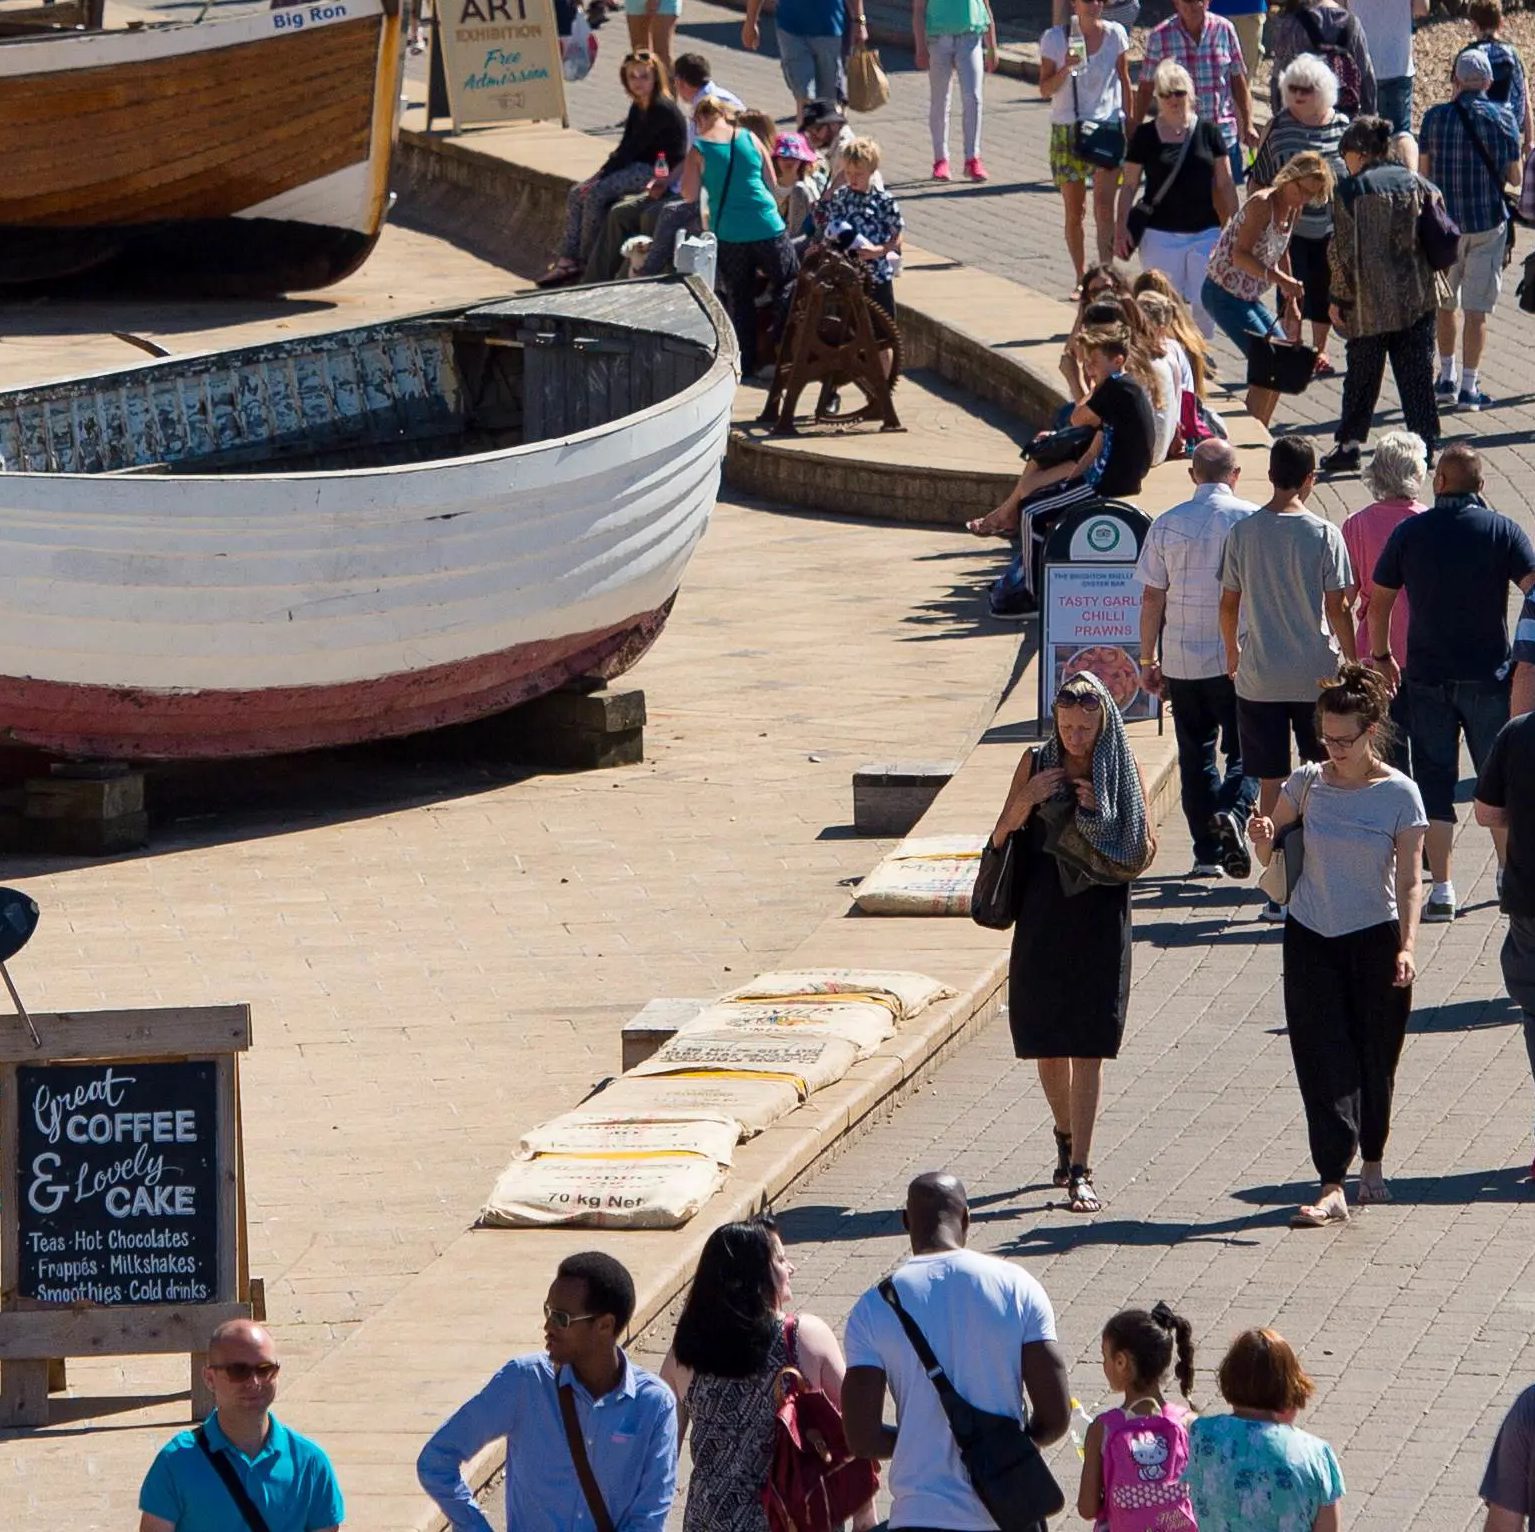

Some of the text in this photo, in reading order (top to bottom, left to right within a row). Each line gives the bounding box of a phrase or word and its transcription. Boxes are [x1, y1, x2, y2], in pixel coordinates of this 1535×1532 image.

[273, 5, 347, 29] Big Ron
[456, 25, 542, 42] EXHIBITION
[484, 48, 522, 69] Free
[464, 63, 549, 90] Admission
[1058, 597, 1099, 607] TASTY
[1082, 611, 1125, 622] CHILLI
[1074, 626, 1133, 637] PRAWNS
[32, 1068, 137, 1144] Great
[66, 1110, 198, 1144] COFFEE
[28, 1143, 184, 1214] & Lovely
[105, 1186, 196, 1218] CAKE
[548, 1192, 644, 1208] 70 kg Net
[29, 1228, 189, 1252] Teas Hot Chocolates
[38, 1253, 196, 1281] Frappés Milkshakes
[37, 1279, 207, 1304] Smoothies Cold drinks
